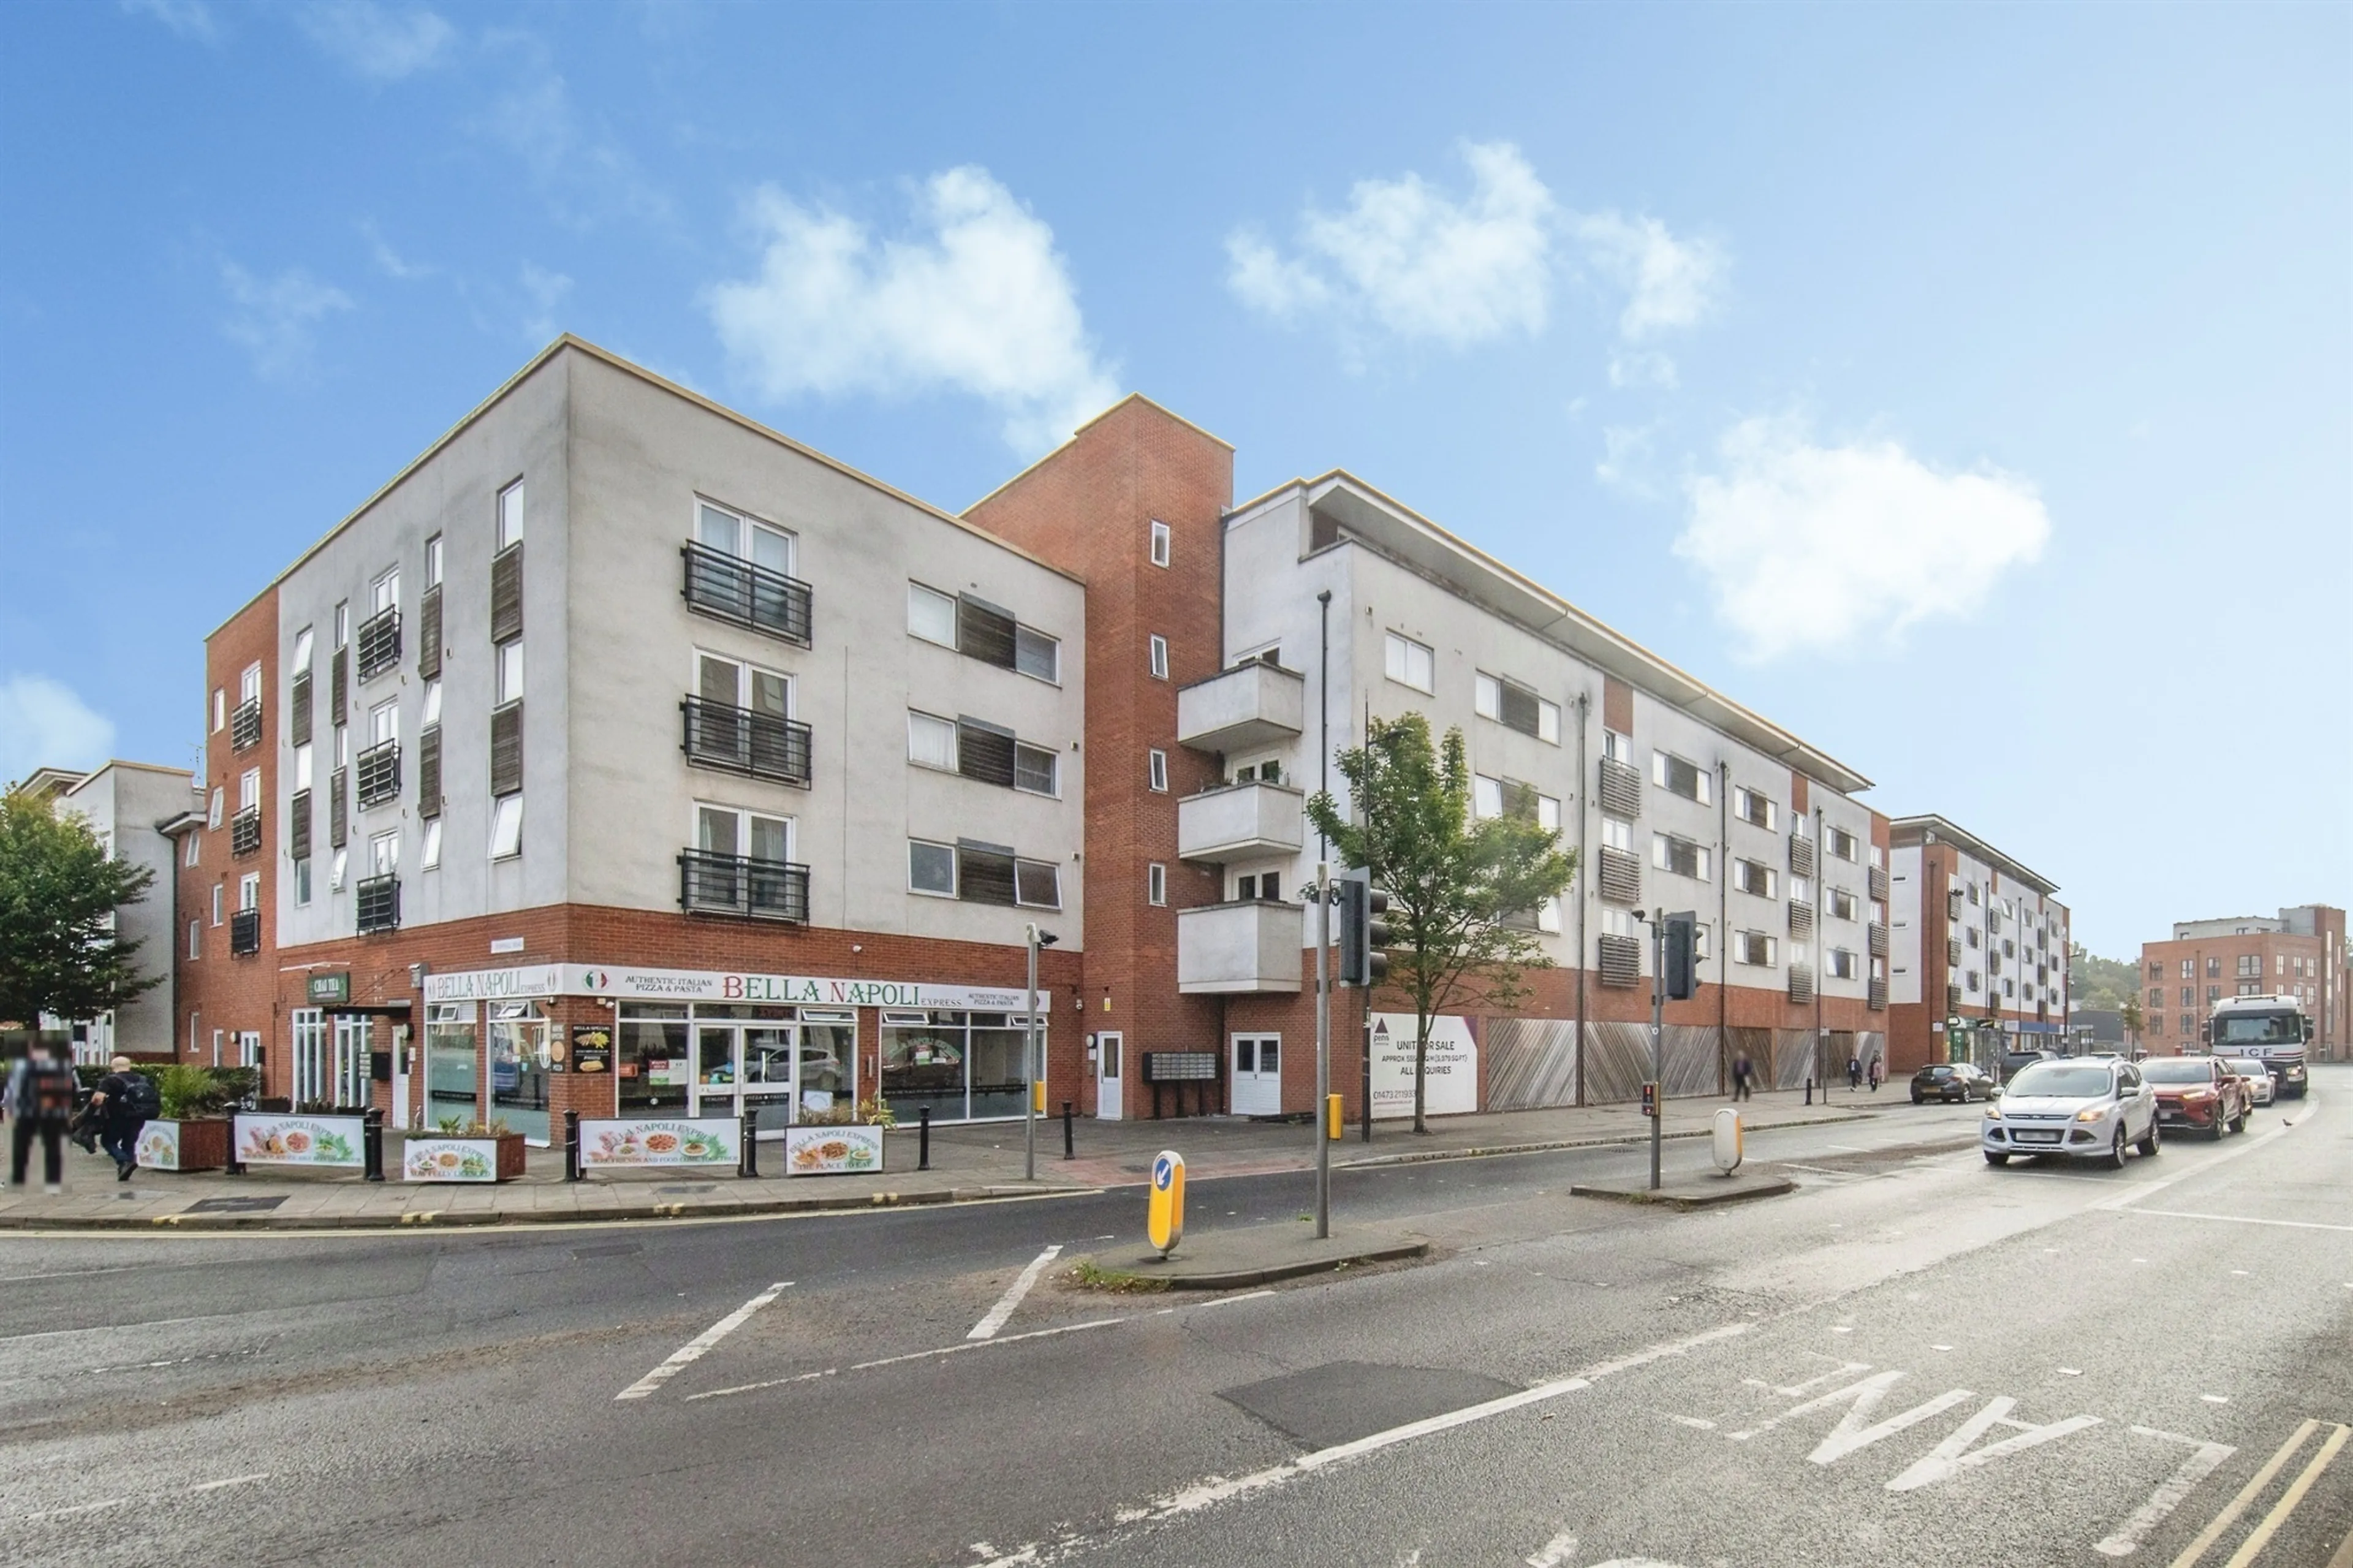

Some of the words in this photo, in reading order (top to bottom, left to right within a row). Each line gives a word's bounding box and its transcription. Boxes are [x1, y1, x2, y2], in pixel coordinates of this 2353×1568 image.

[438, 975, 474, 999] BELLA
[477, 971, 521, 996] NAPOLI
[521, 983, 545, 993] EXPRESS
[625, 975, 676, 985] AUTHENTIC
[678, 978, 713, 987] ITALIAN
[722, 975, 821, 1001] BELLA
[830, 982, 919, 1006] NAPOLI
[921, 998, 962, 1007] EXPRESS
[1396, 1040, 1417, 1050] UNIT
[1436, 1041, 1455, 1050] SALE
[2240, 1048, 2273, 1057] ICF
[1400, 1066, 1414, 1075] ALL
[1425, 1066, 1452, 1075] QUIRIES
[635, 1122, 675, 1135] NAPOLI
[814, 1130, 846, 1139] NAPOLI
[847, 1131, 880, 1151] EXPRESS
